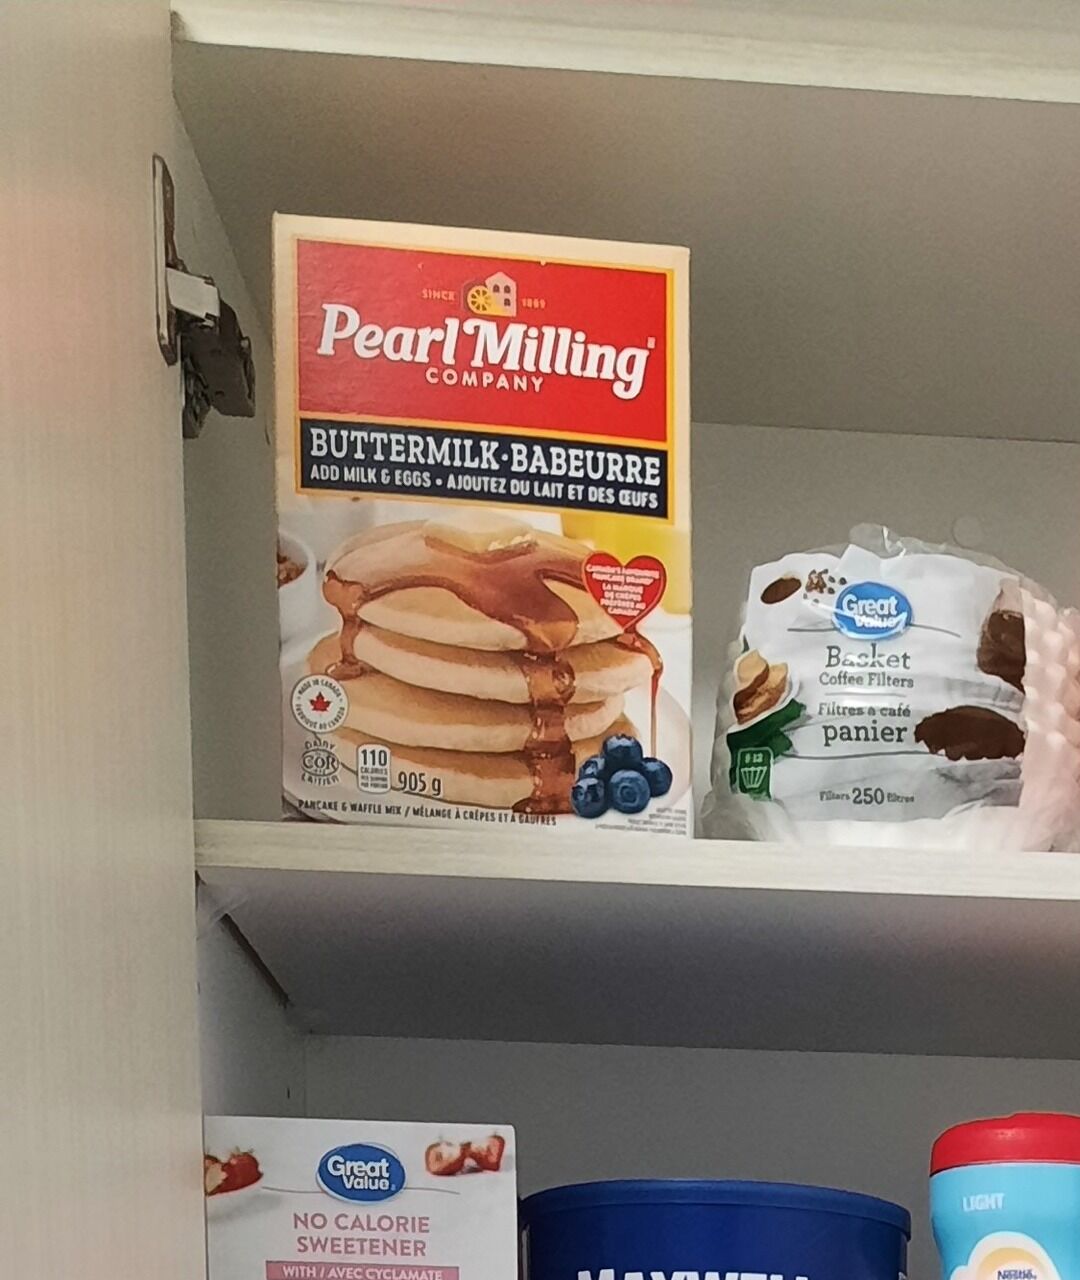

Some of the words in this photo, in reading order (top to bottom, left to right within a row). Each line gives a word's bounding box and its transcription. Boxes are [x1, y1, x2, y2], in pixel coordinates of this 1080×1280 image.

[317, 303, 460, 364] Pearl
[463, 318, 651, 399] Milling
[425, 367, 544, 393] COMPANY
[310, 427, 500, 471] BUTTERMILK
[511, 443, 661, 486] BABEURRE
[310, 464, 339, 482] ADD
[344, 466, 377, 485] MILK
[381, 469, 391, 486] &
[395, 470, 431, 489] EGGS
[447, 474, 507, 494] AJOUTEZ
[511, 478, 530, 496] DU
[534, 480, 563, 498] LAIT
[568, 482, 585, 500] ET
[589, 484, 615, 504] DES
[842, 593, 899, 617] Great
[825, 642, 911, 669] Basket
[819, 672, 864, 687] Coffee
[867, 672, 914, 689] Filters
[818, 703, 863, 717] Filtres
[880, 702, 911, 718] café
[822, 720, 908, 746] panier
[360, 749, 388, 766] 110
[398, 771, 427, 792] 905
[431, 777, 442, 797] g
[852, 787, 885, 805] 250
[299, 800, 338, 812] PANCAKE
[350, 801, 382, 814] WAFFLE
[385, 804, 402, 815] MIX
[412, 804, 452, 820] MÉLANGE
[498, 810, 509, 823] ET
[327, 1155, 390, 1177] Great
[342, 1174, 390, 1191] Value
[962, 1192, 1005, 1212] LIGHT
[293, 1212, 328, 1230] NO
[334, 1213, 431, 1234] CALORIE
[297, 1236, 427, 1257] SWEETENER
[282, 1266, 317, 1279] WITH
[327, 1266, 364, 1280] AVEC
